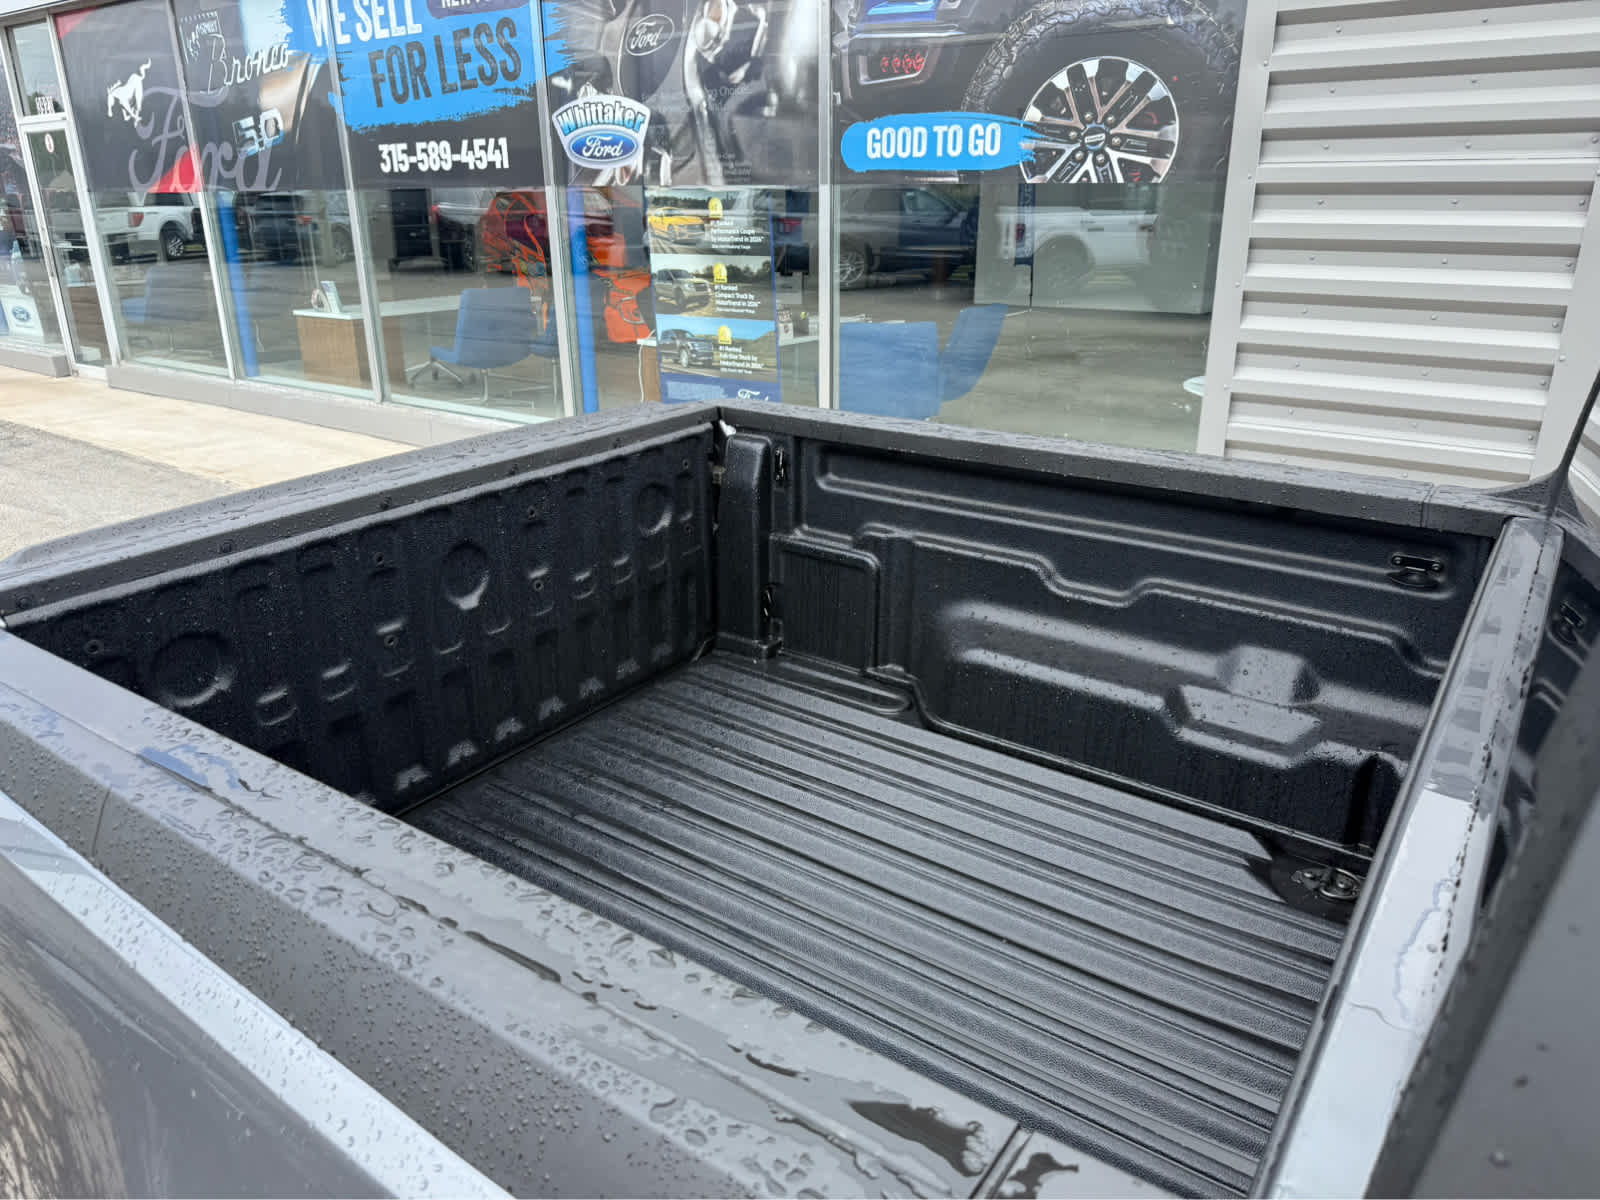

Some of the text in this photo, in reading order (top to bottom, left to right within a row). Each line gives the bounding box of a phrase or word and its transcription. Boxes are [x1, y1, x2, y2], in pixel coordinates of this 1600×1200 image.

[307, 0, 422, 47] WE SELL
[630, 21, 664, 50] Ford
[200, 33, 289, 95] Bronco
[368, 16, 521, 108] FOR LESS
[556, 101, 646, 136] Whittaker
[128, 86, 283, 192] Ford
[378, 136, 510, 173] 315-589-4541
[582, 135, 624, 157] Ford
[866, 122, 1001, 159] GOOD TO GO
